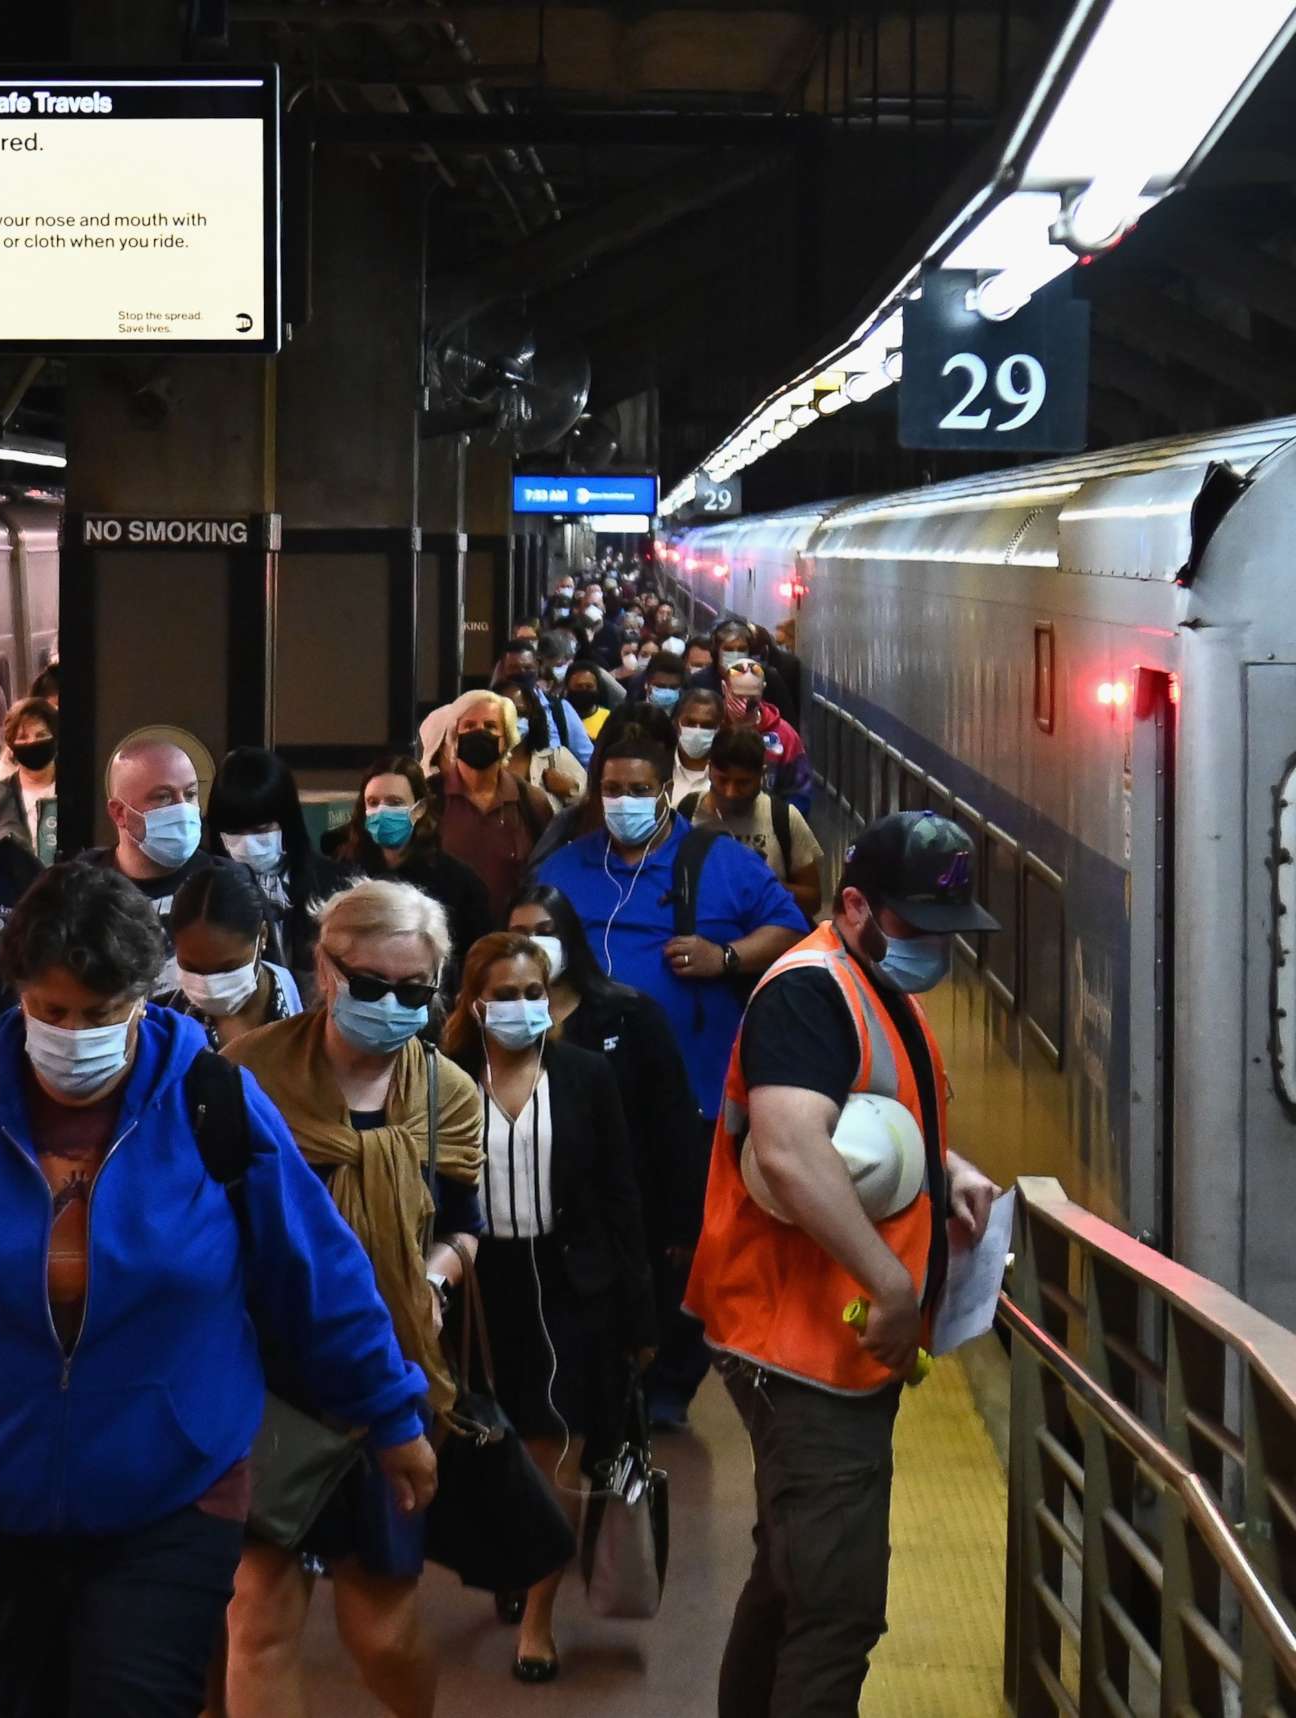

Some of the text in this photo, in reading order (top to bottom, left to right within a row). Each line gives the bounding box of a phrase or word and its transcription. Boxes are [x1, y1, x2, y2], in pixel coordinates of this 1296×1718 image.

[34, 91, 113, 114] Travels
[35, 216, 76, 227] nose
[79, 212, 111, 227] and
[114, 212, 168, 227] mouth
[171, 212, 207, 227] with
[3, 237, 20, 249] or
[24, 234, 66, 249] cloth
[69, 233, 115, 248] when
[119, 237, 149, 251] you
[153, 234, 189, 248] ride.
[118, 310, 144, 321] Stop
[146, 311, 163, 321] the
[118, 323, 144, 334] Save
[937, 352, 1047, 432] 29
[703, 489, 733, 512] 29
[85, 520, 248, 544] NO SMOKING
